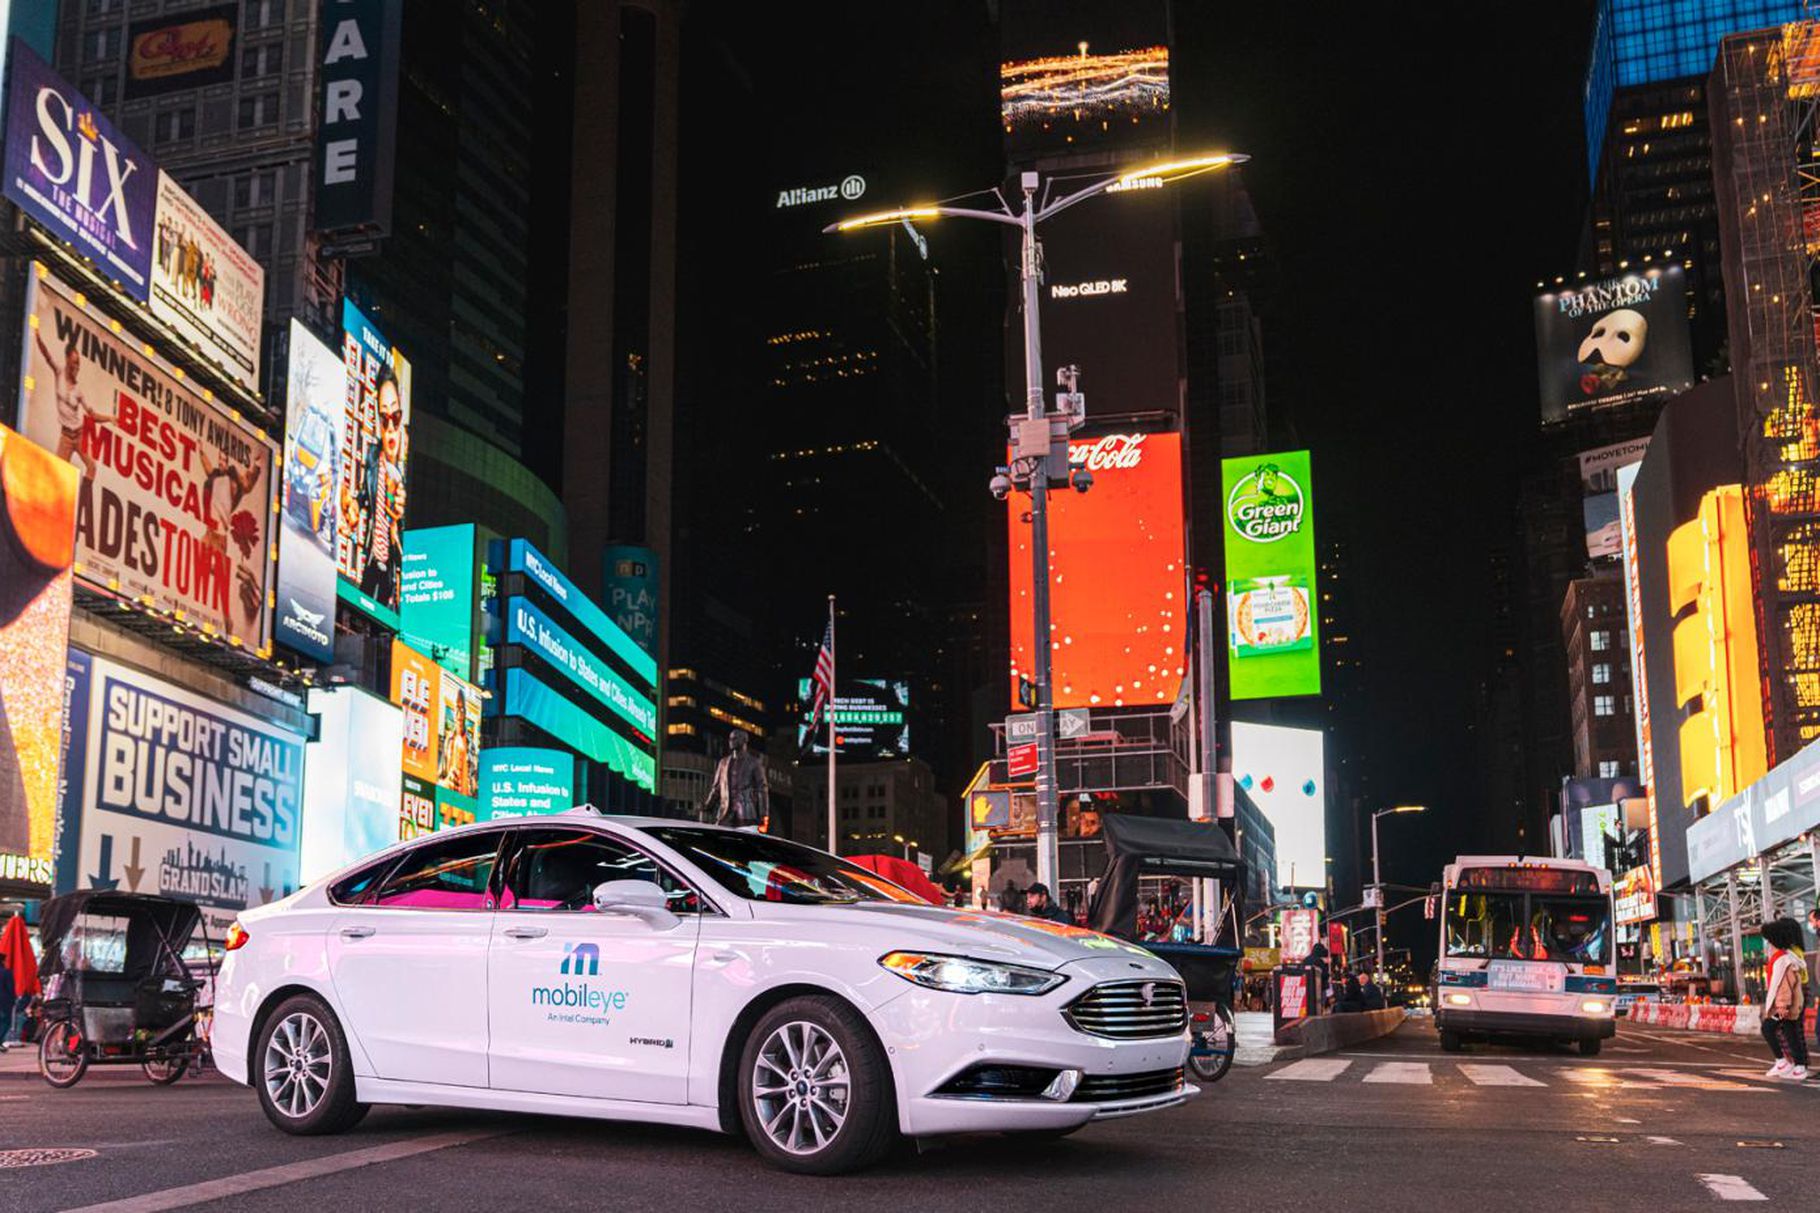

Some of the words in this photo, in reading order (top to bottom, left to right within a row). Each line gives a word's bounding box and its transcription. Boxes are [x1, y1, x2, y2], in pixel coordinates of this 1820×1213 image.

[324, 0, 368, 187] ARE
[30, 87, 138, 250] SIX
[52, 184, 72, 213] THE
[776, 185, 838, 208] Allianz
[1051, 285, 1078, 298] Neo
[1079, 281, 1110, 295] QLED
[1111, 279, 1127, 293] 8K
[1559, 276, 1660, 312] PHANTOM
[1611, 292, 1651, 308] OPERA
[54, 308, 163, 407] WINNER!
[165, 388, 173, 415] 8
[176, 394, 205, 437] TONY
[207, 419, 251, 469] AWARDS
[117, 391, 197, 471] BEST
[82, 414, 219, 530] MUSICAL
[1237, 503, 1299, 520] Green
[1245, 518, 1301, 536] Giant
[419, 581, 443, 590] Cities
[612, 587, 656, 611] PLAY
[517, 608, 538, 642] U.S.
[538, 623, 568, 666] Infusion
[569, 649, 577, 672] to
[577, 655, 599, 688] States
[599, 677, 611, 698] and
[611, 682, 628, 710] Cities
[109, 685, 225, 761] SUPPORT
[229, 729, 295, 782] SMALL
[492, 764, 508, 773] NYC
[510, 764, 532, 773] Local
[533, 764, 554, 775] News
[103, 731, 295, 843] BUSINESS
[492, 782, 515, 793] U.S.
[518, 782, 561, 796] Infusion
[561, 786, 569, 798] to
[491, 796, 527, 808] States
[529, 798, 551, 809] and
[160, 863, 209, 897] GRAND
[210, 872, 248, 902] SLAM
[532, 983, 625, 1014] mobileye
[560, 1014, 574, 1022] Intel
[575, 1014, 610, 1025] Company
[630, 1036, 666, 1047] HYBRID
